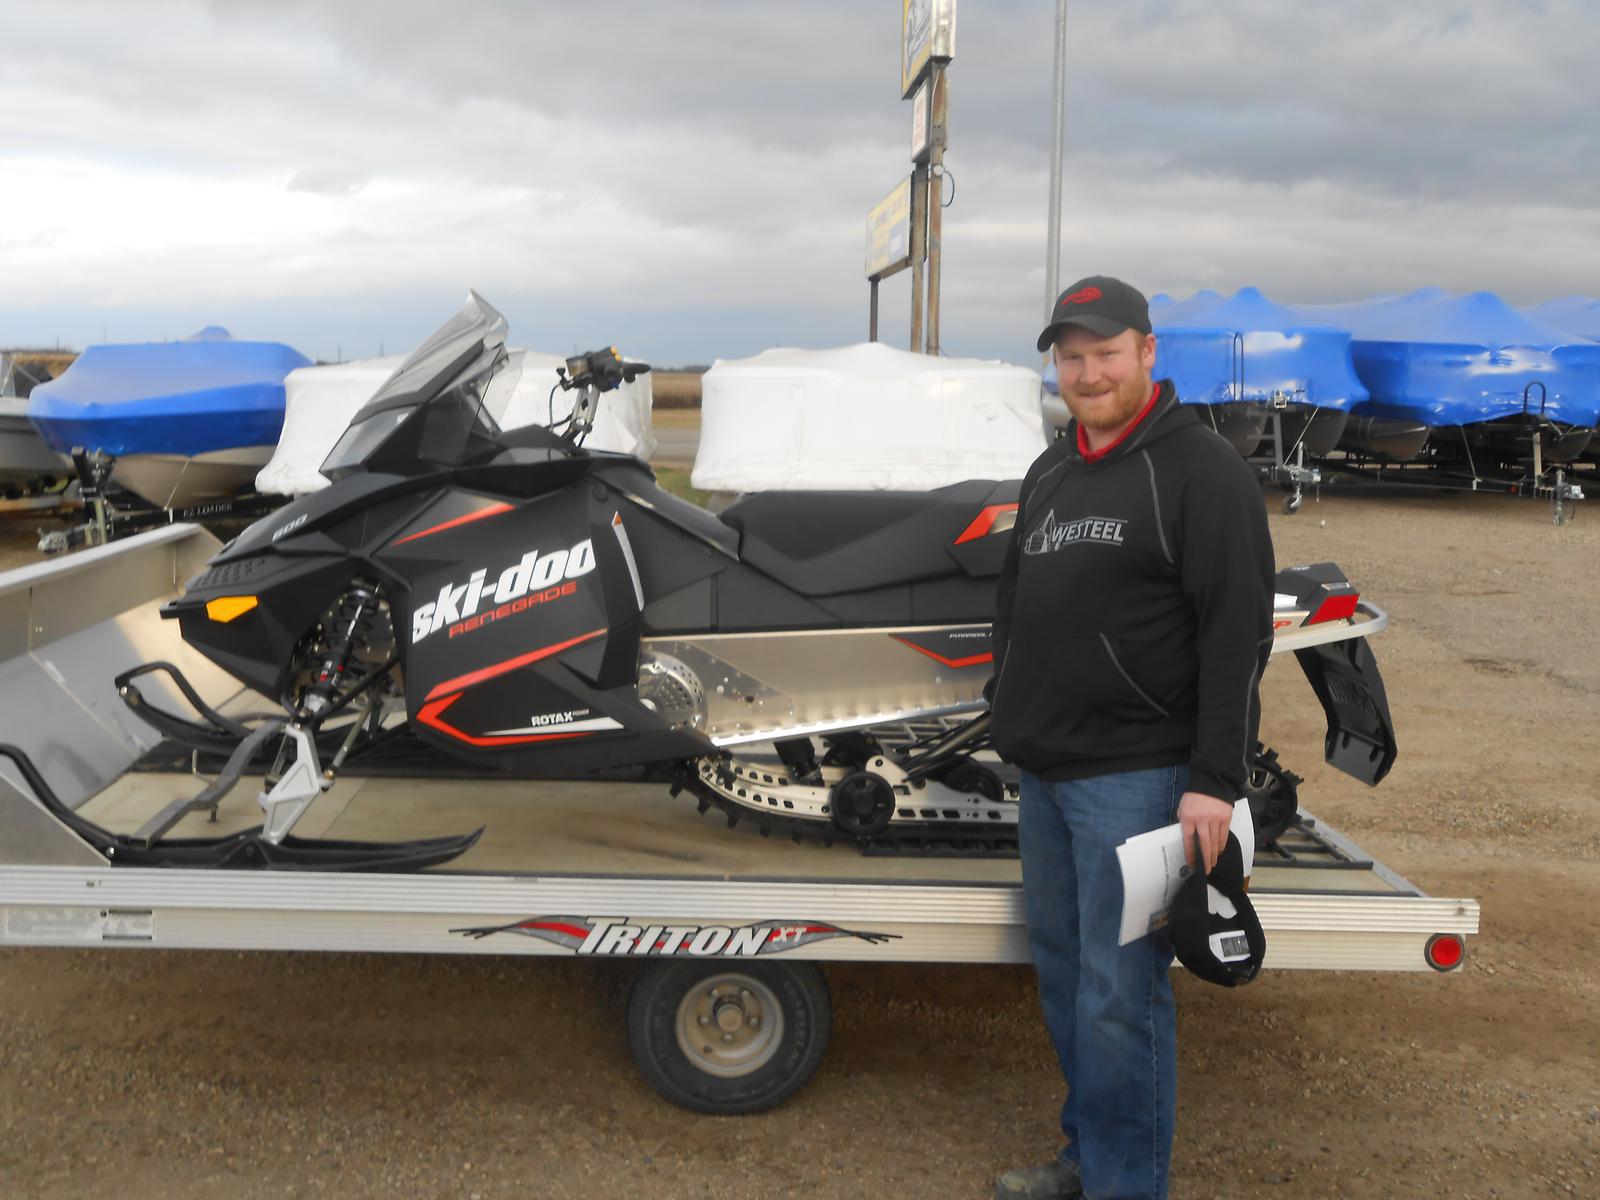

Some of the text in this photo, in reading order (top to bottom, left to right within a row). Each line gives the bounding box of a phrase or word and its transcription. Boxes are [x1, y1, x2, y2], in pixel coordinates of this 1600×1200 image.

[1051, 520, 1124, 551] WESTEEL
[412, 538, 596, 644] ski-doo
[449, 581, 577, 639] RENEGADE
[531, 711, 573, 727] ROTAX
[576, 915, 807, 956] TRITON XT
